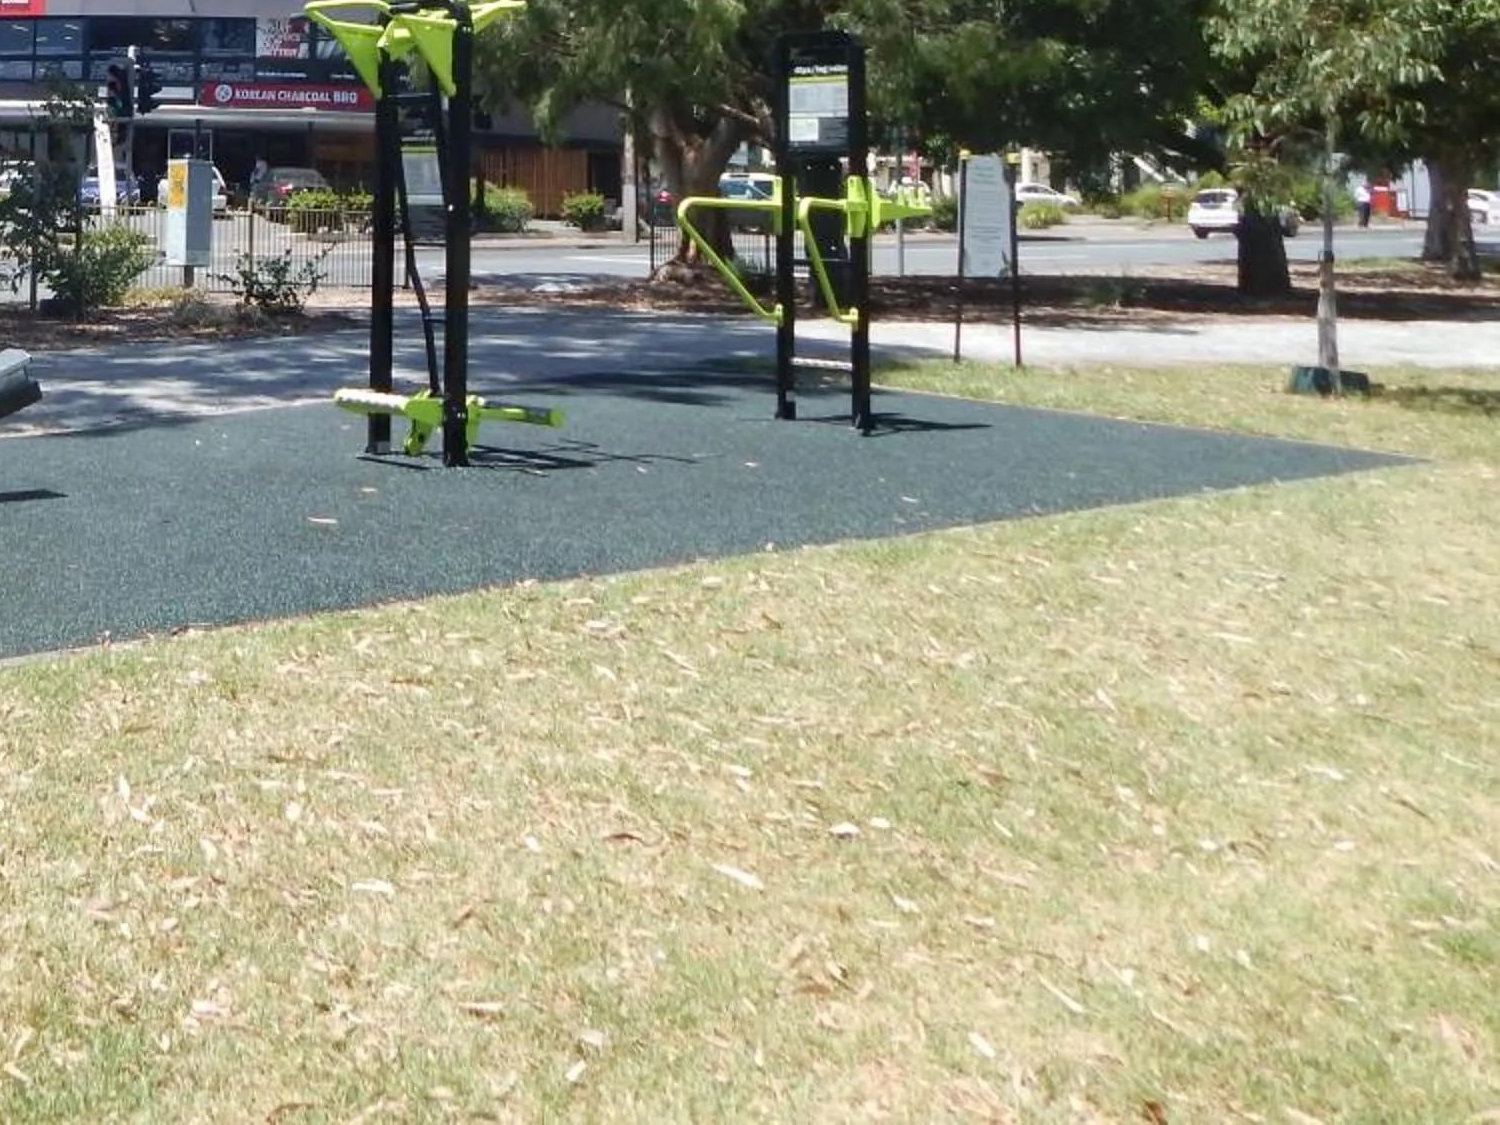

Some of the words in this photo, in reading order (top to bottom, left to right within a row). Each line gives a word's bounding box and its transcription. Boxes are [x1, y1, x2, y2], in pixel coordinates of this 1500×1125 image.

[235, 89, 276, 101] KOREAN
[278, 90, 331, 103] CHARCOAL
[333, 90, 357, 104] BBQ
